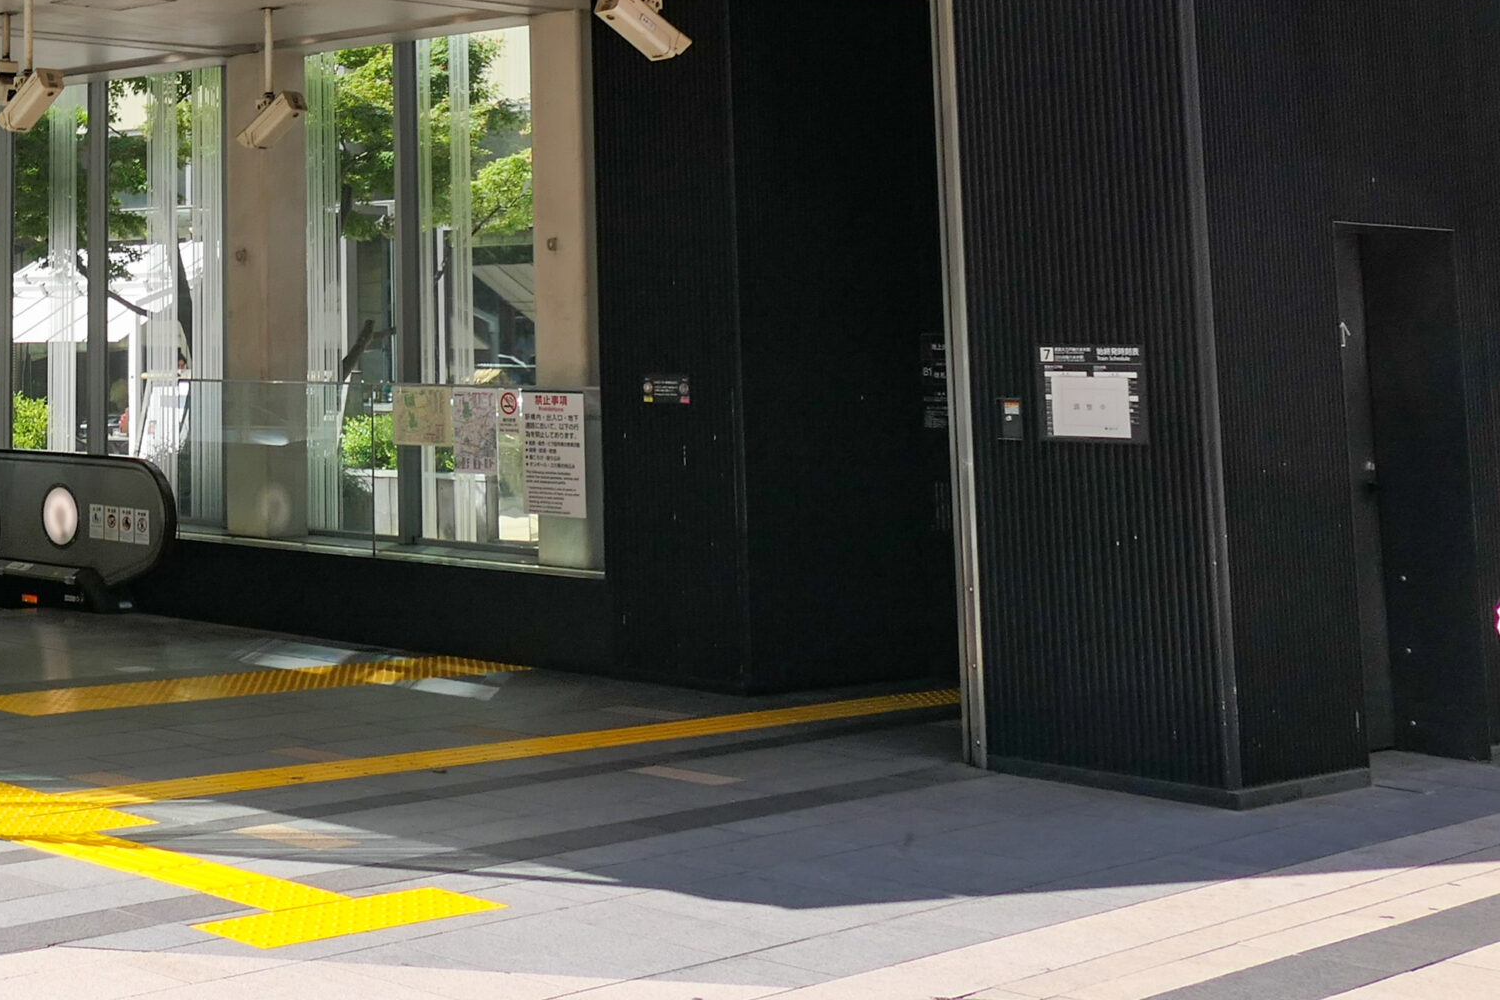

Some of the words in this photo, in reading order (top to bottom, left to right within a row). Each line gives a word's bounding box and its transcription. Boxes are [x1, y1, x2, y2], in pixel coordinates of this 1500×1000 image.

[1043, 348, 1051, 360] 7
[534, 394, 568, 406] 禁止事項
